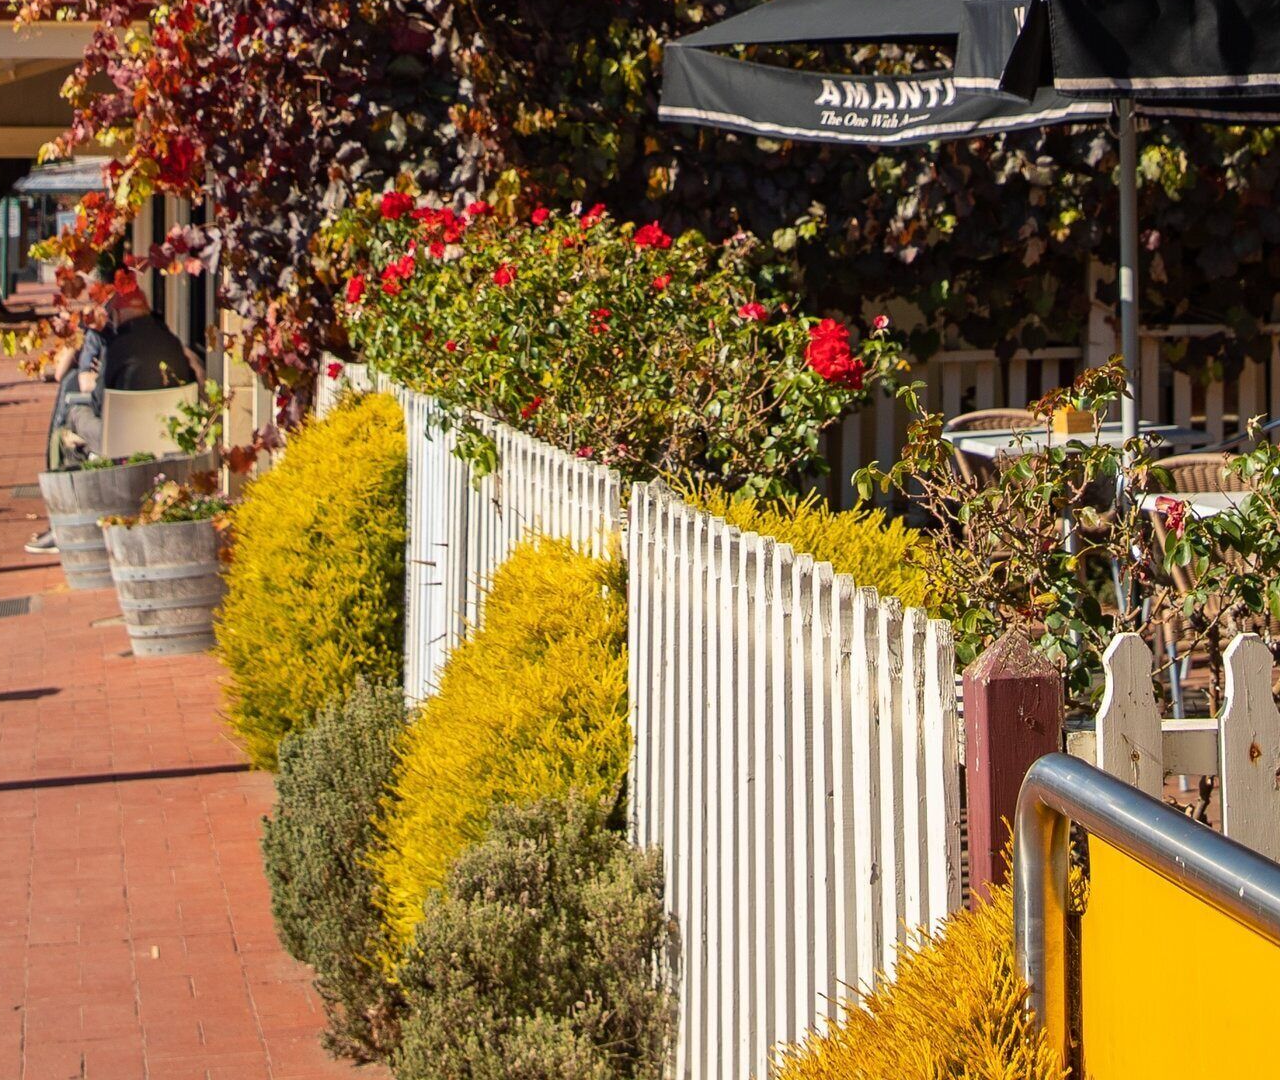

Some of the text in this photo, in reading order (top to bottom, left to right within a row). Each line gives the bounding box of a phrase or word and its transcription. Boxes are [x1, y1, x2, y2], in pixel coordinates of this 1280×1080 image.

[814, 77, 957, 110] AMANTI
[821, 110, 842, 126] The
[843, 112, 869, 127] One
